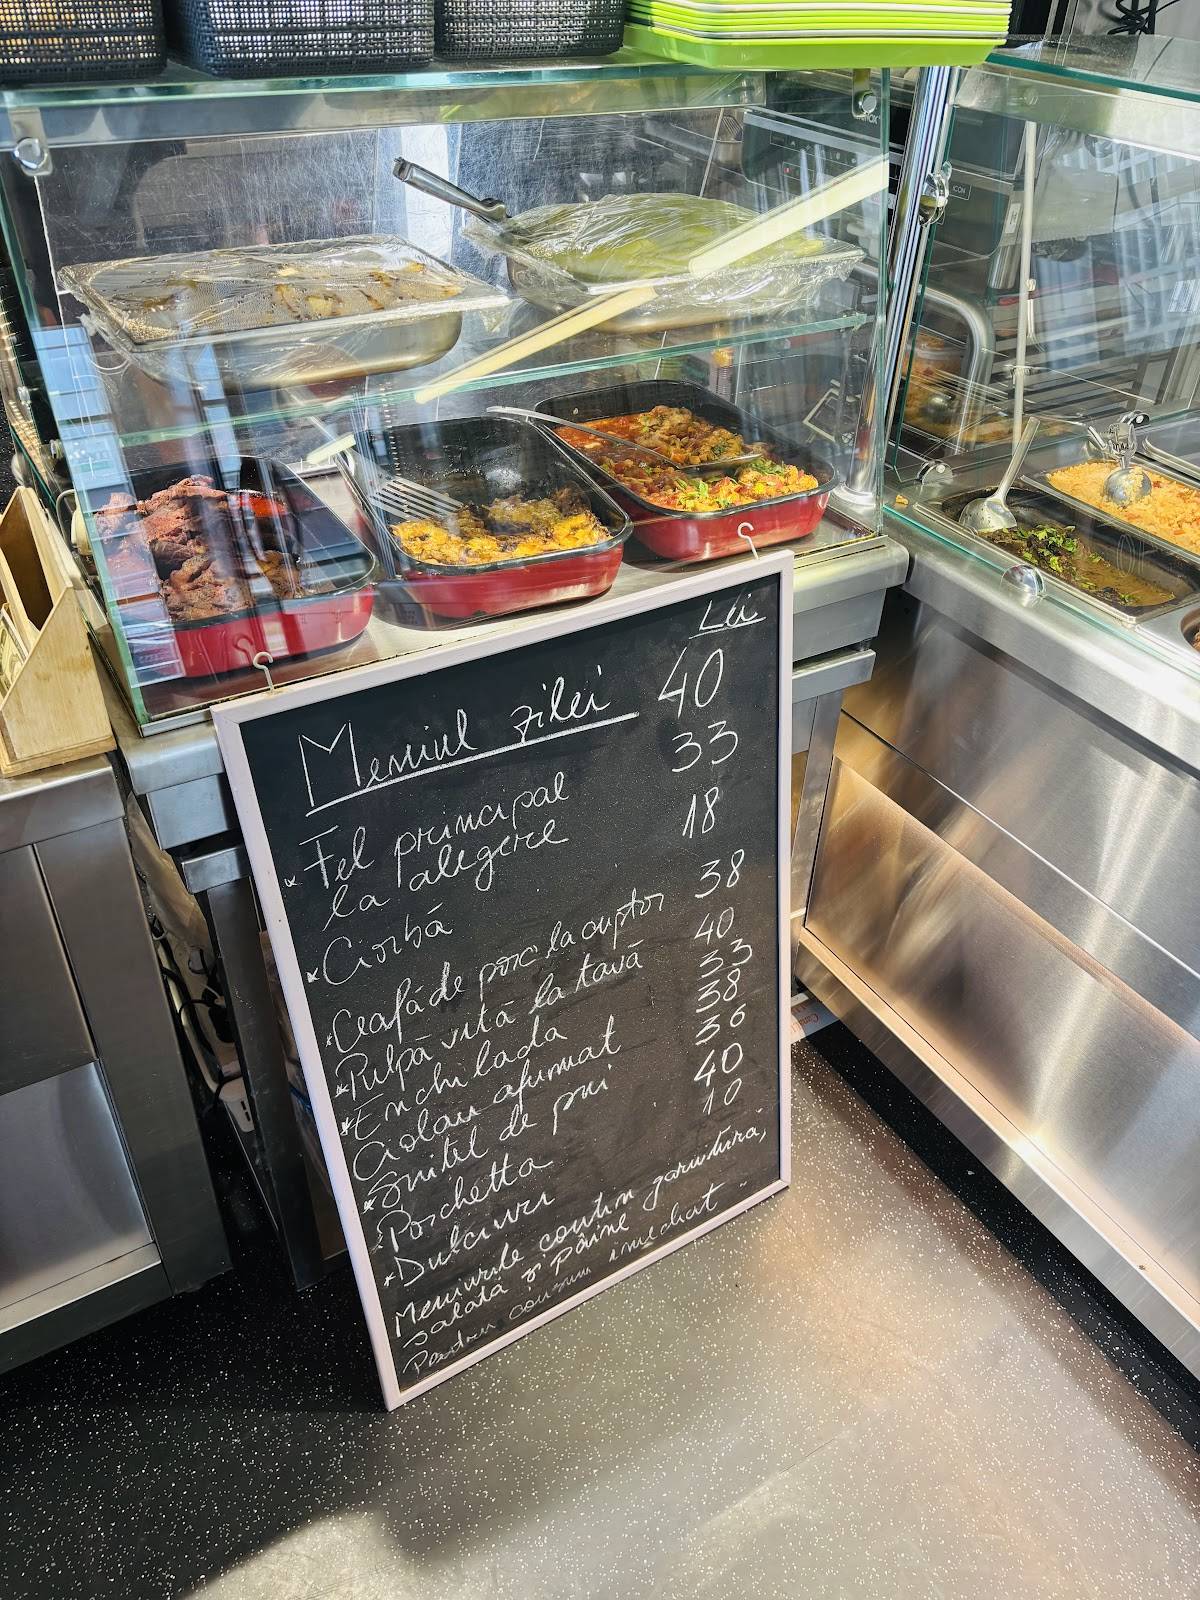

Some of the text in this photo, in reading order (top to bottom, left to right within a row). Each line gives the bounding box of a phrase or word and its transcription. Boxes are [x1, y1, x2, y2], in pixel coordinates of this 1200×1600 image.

[699, 594, 760, 632] Lei
[298, 646, 723, 807] Meniul zilei 40
[298, 720, 739, 889] Fel principal 33
[682, 786, 719, 838] 18
[322, 819, 569, 932] la alegere
[429, 961, 466, 1007] de
[480, 944, 538, 1002] porc
[545, 921, 576, 959] la
[581, 888, 664, 949] cuptor
[695, 849, 744, 898] 38
[528, 973, 566, 1015] la
[694, 907, 734, 944] 40
[700, 939, 752, 978] 33
[353, 968, 741, 1181] Ciolan afumat 38
[499, 1104, 537, 1141] de
[552, 1064, 612, 1136] pui
[695, 1004, 746, 1045] 36
[703, 1078, 742, 1115] 10
[377, 1043, 743, 1253] Porchetta 40
